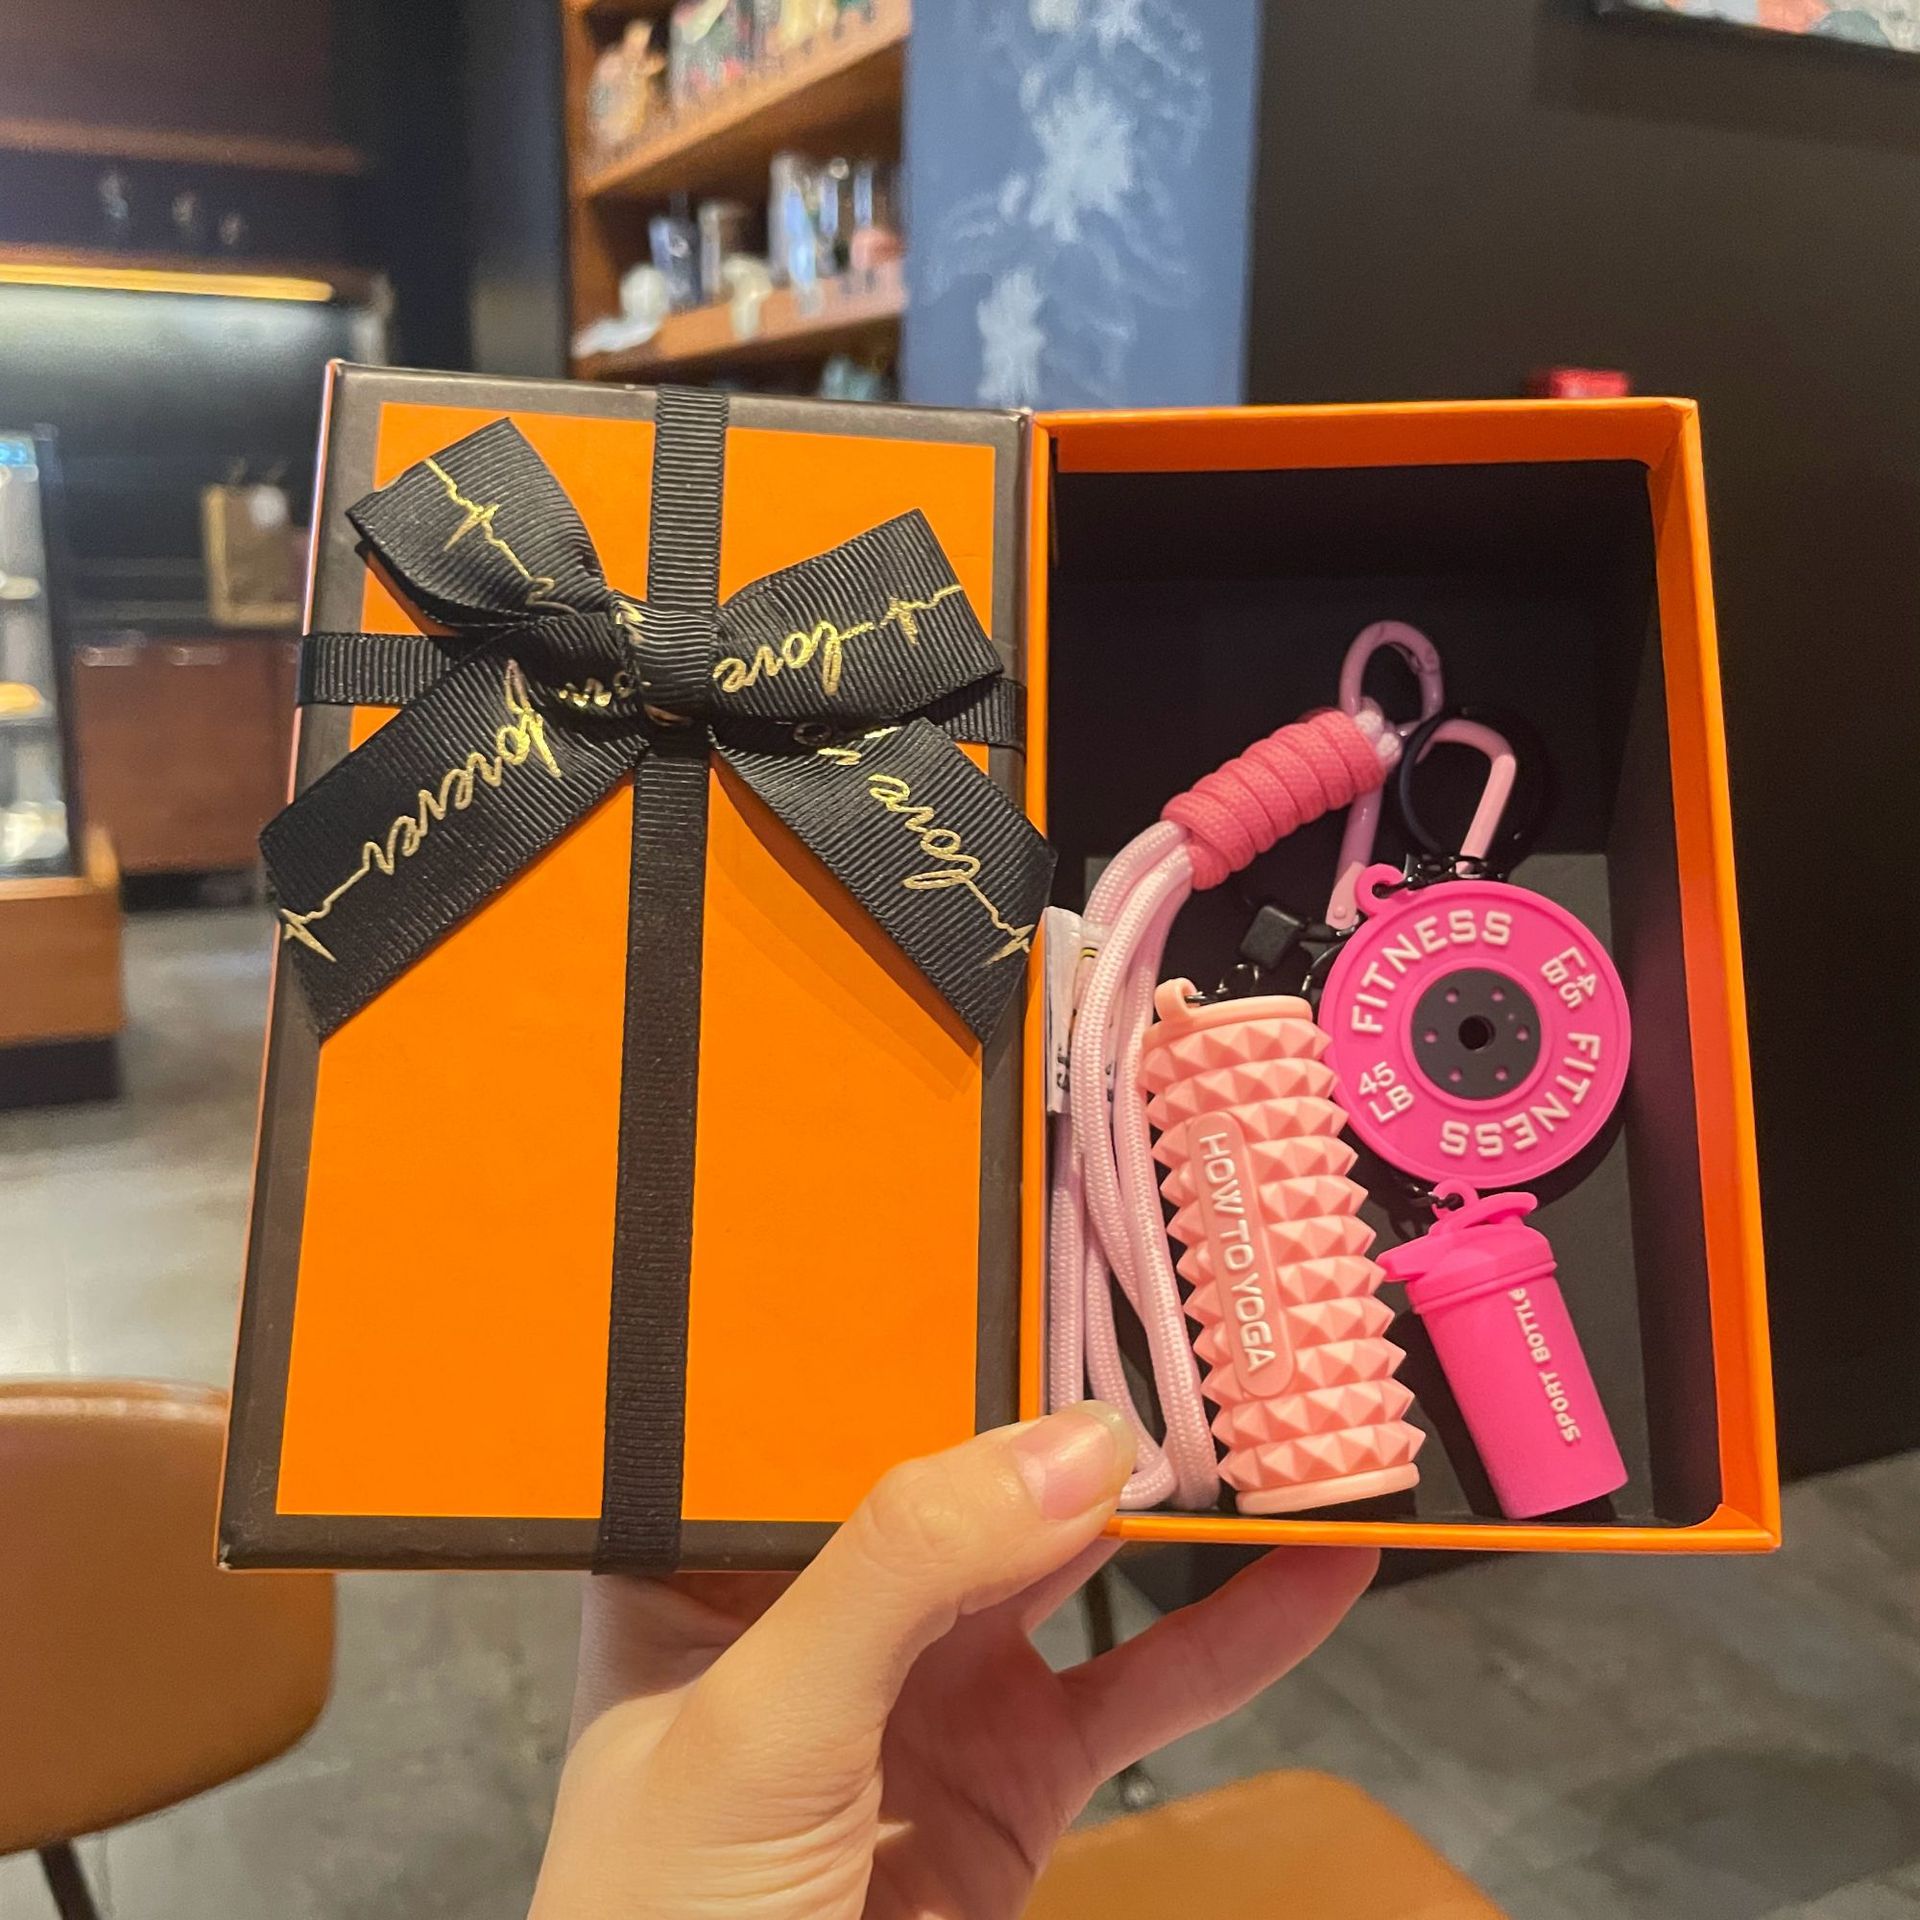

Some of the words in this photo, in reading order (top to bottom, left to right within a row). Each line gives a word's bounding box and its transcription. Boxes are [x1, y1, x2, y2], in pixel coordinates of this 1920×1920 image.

[711, 619, 844, 696] love
[866, 773, 982, 891] love
[1351, 909, 1513, 1034] FITNESS
[1540, 946, 1587, 983] LB
[1558, 972, 1598, 1009] 45
[1359, 1061, 1396, 1095] 45
[1368, 1084, 1415, 1124] LB
[1439, 1032, 1601, 1158] FITNESS
[1199, 1132, 1245, 1215] HOW
[1219, 1219, 1255, 1272] TO
[1231, 1272, 1277, 1373] YOGA
[1537, 1370, 1581, 1443] SPORT
